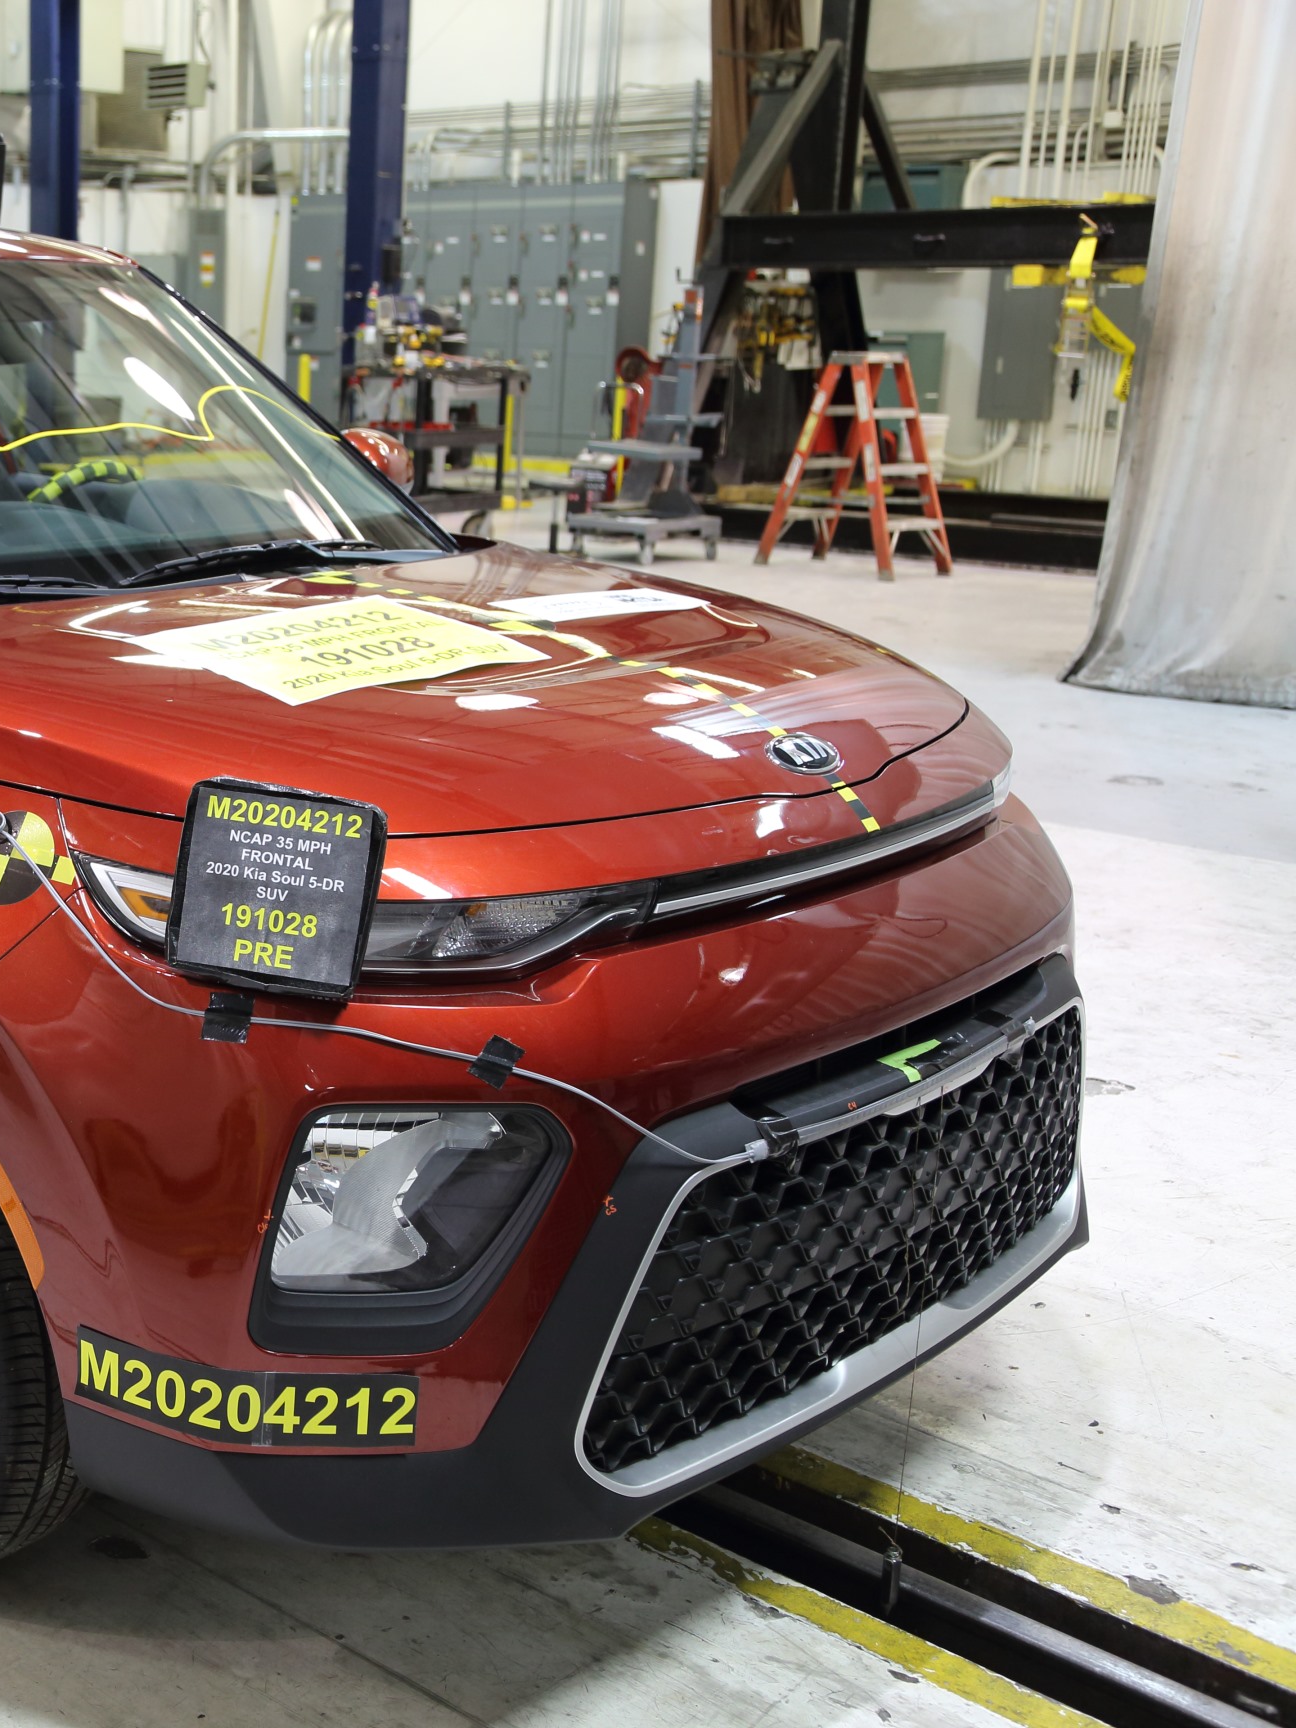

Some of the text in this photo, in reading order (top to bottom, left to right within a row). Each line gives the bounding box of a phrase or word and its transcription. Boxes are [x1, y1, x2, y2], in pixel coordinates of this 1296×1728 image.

[191, 611, 402, 651] M20204212
[303, 634, 352, 647] MPH
[350, 620, 445, 638] FRONTAL
[283, 672, 337, 690] 2020
[371, 660, 422, 674] Soul
[419, 648, 467, 665] 5-DR
[466, 643, 509, 655] SUV
[301, 636, 436, 668] 191028
[207, 795, 363, 838] M20204212
[229, 829, 332, 855] NCAP 35 MPH
[241, 849, 314, 871] FRONTAL
[206, 861, 345, 893] 2020 Kia Soul 5-DR
[256, 886, 289, 902] SUV
[221, 902, 318, 938] 191028
[233, 938, 294, 970] PRE
[79, 1339, 417, 1435] M20204212
